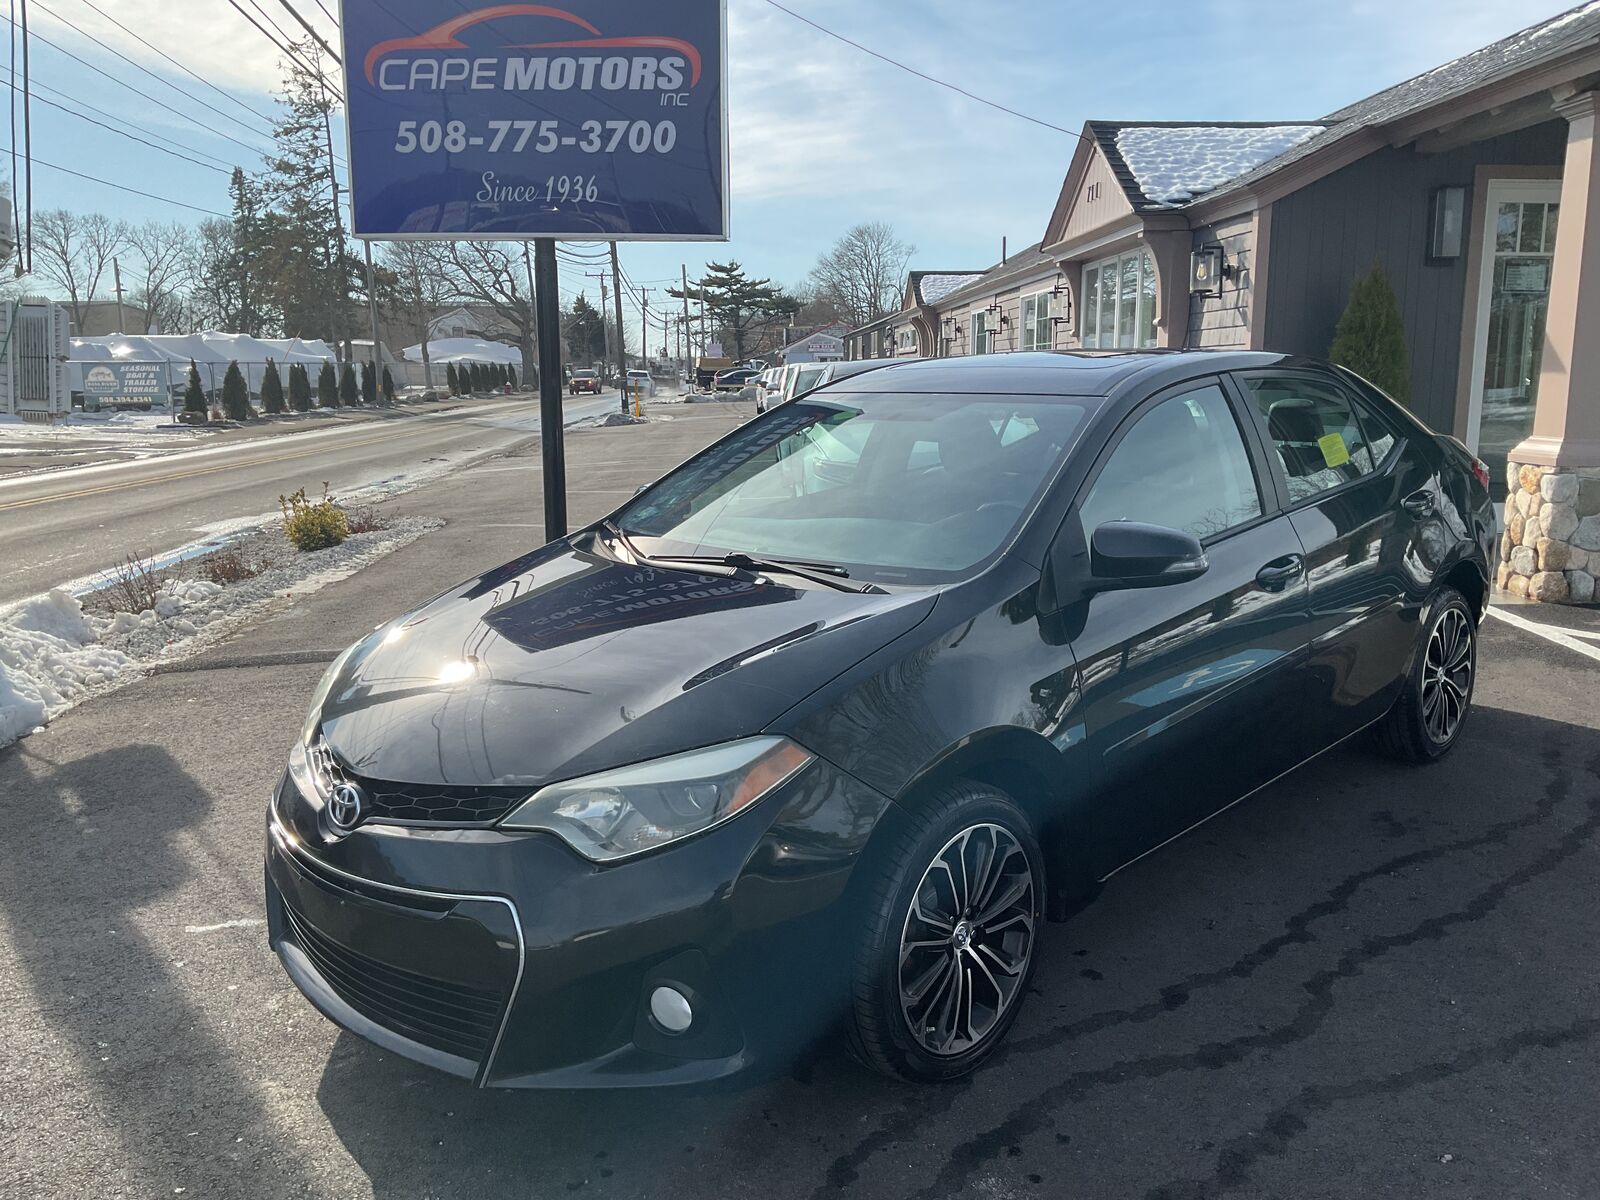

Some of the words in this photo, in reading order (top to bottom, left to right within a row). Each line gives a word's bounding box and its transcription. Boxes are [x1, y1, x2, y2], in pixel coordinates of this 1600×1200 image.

[379, 58, 497, 90] CAPE
[504, 57, 685, 90] MOTORS
[395, 120, 677, 153] 508-775-3700
[476, 171, 539, 202] Since
[545, 175, 599, 203] 1936
